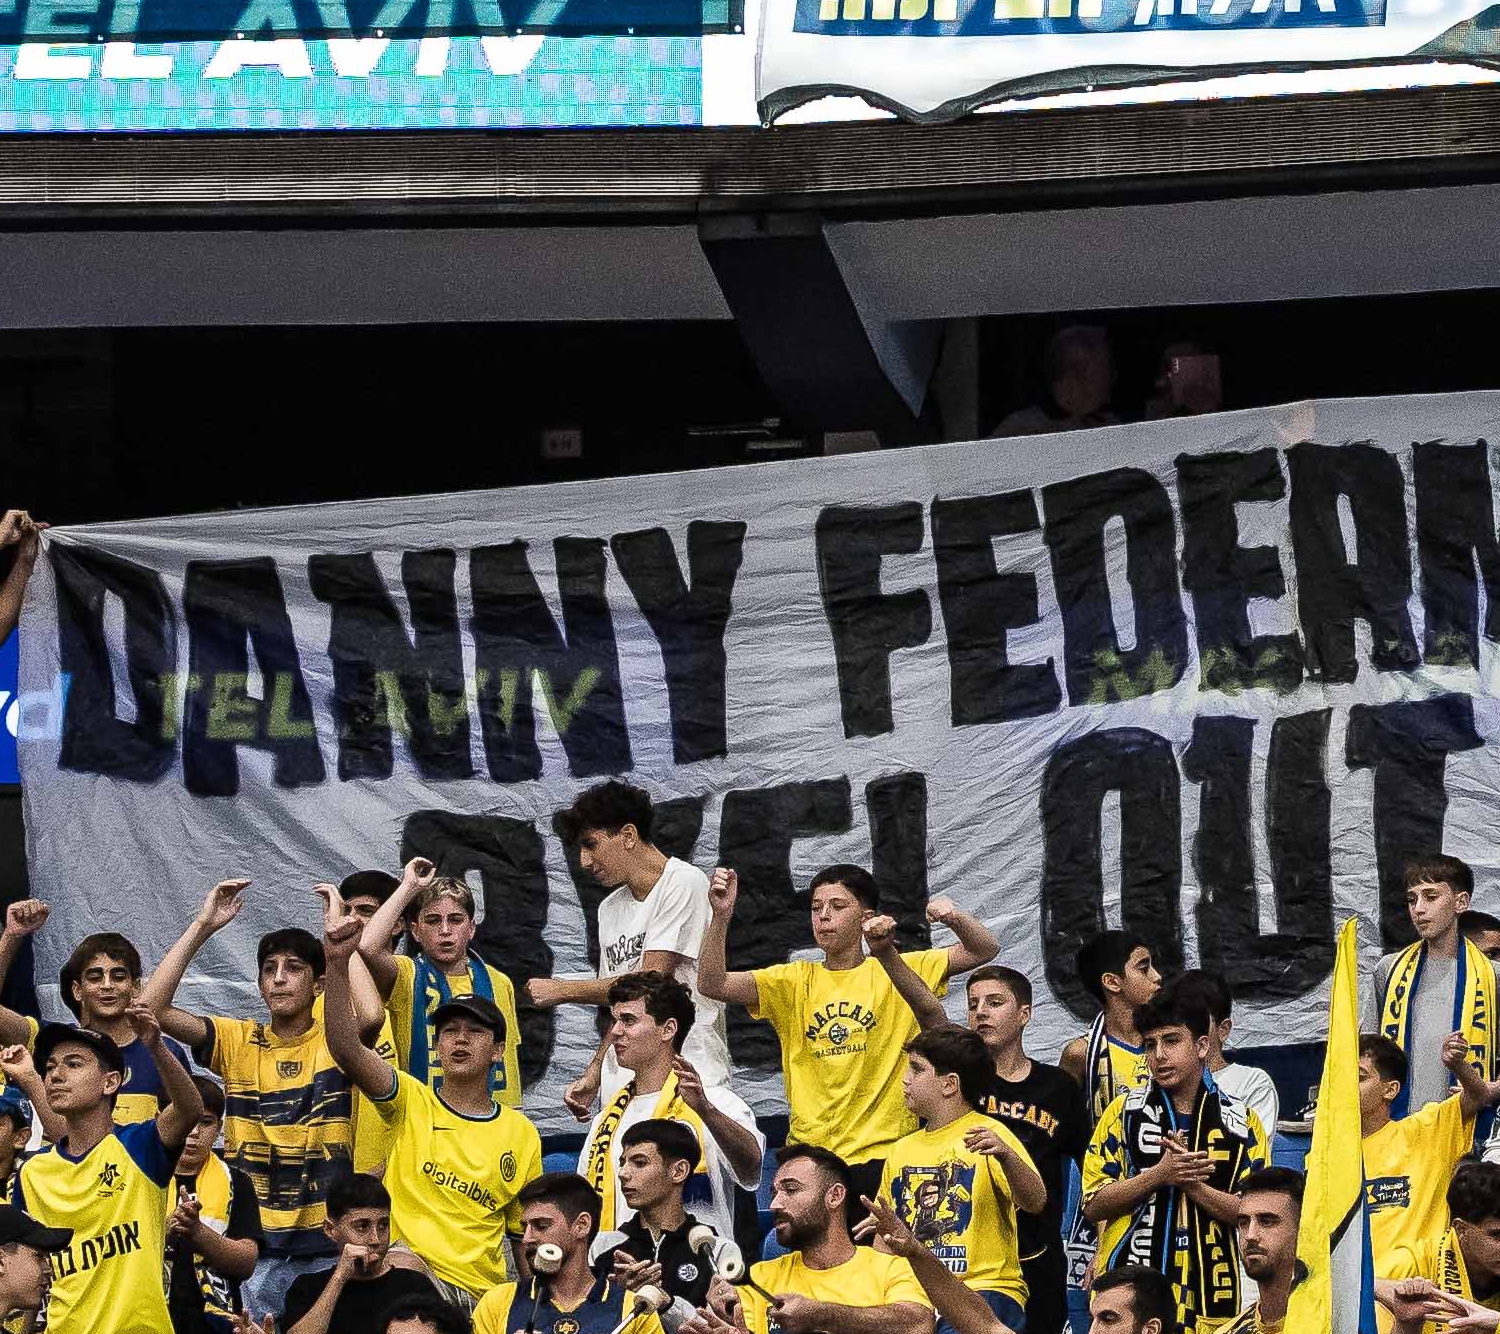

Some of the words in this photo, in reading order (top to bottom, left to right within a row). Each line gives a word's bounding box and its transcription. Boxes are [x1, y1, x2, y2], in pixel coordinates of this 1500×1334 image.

[46, 517, 749, 798] DANNY
[805, 1002, 879, 1043] MACCABI
[422, 1158, 498, 1213] digitalbits
